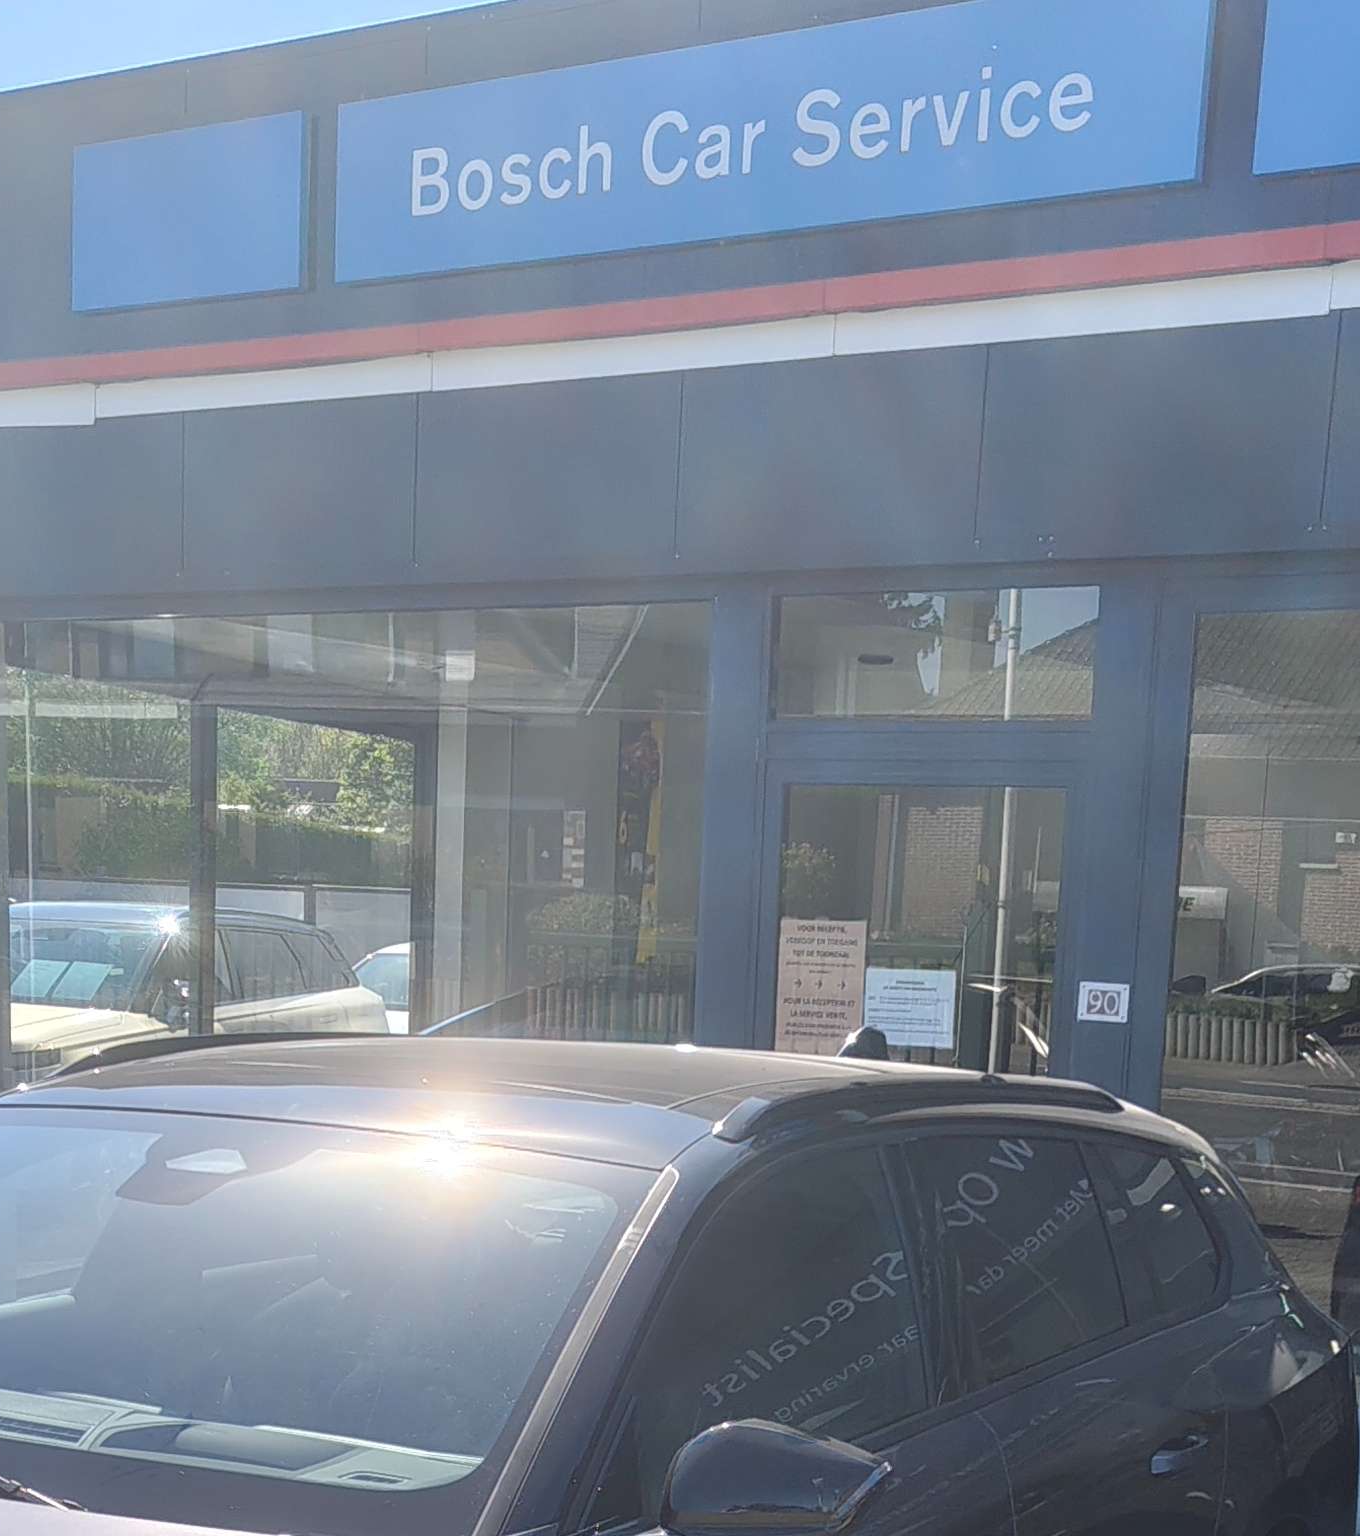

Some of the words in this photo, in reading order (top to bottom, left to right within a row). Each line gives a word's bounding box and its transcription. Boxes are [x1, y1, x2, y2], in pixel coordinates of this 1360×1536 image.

[410, 126, 612, 217] Bosch
[642, 110, 766, 187] Car
[792, 66, 1095, 168] Service
[1088, 989, 1119, 1014] 90
